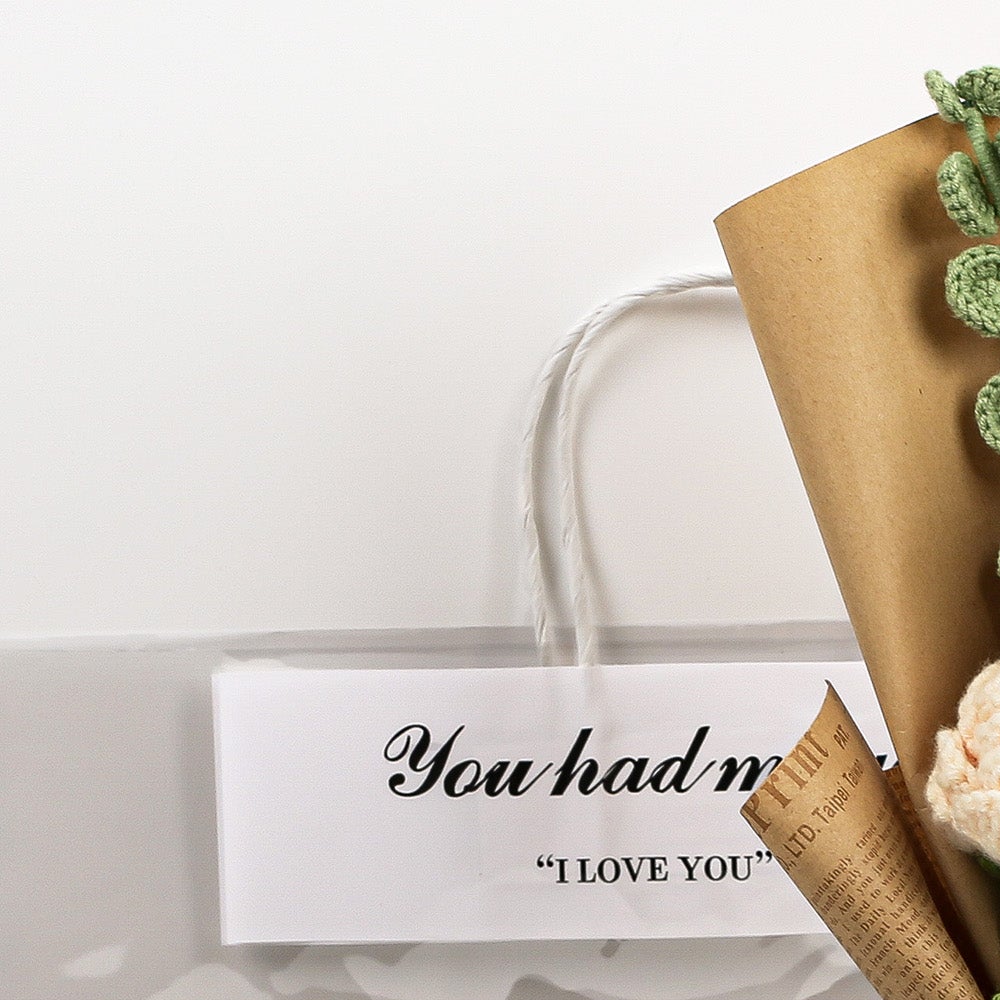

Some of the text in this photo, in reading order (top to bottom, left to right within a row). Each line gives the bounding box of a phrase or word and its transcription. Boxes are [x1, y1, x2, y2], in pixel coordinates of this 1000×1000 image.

[385, 726, 552, 798] You
[552, 727, 714, 797] had
[784, 823, 821, 858] LTD.
[811, 785, 851, 824] Taipei
[578, 858, 669, 884] LOVE
[871, 888, 880, 899] to
